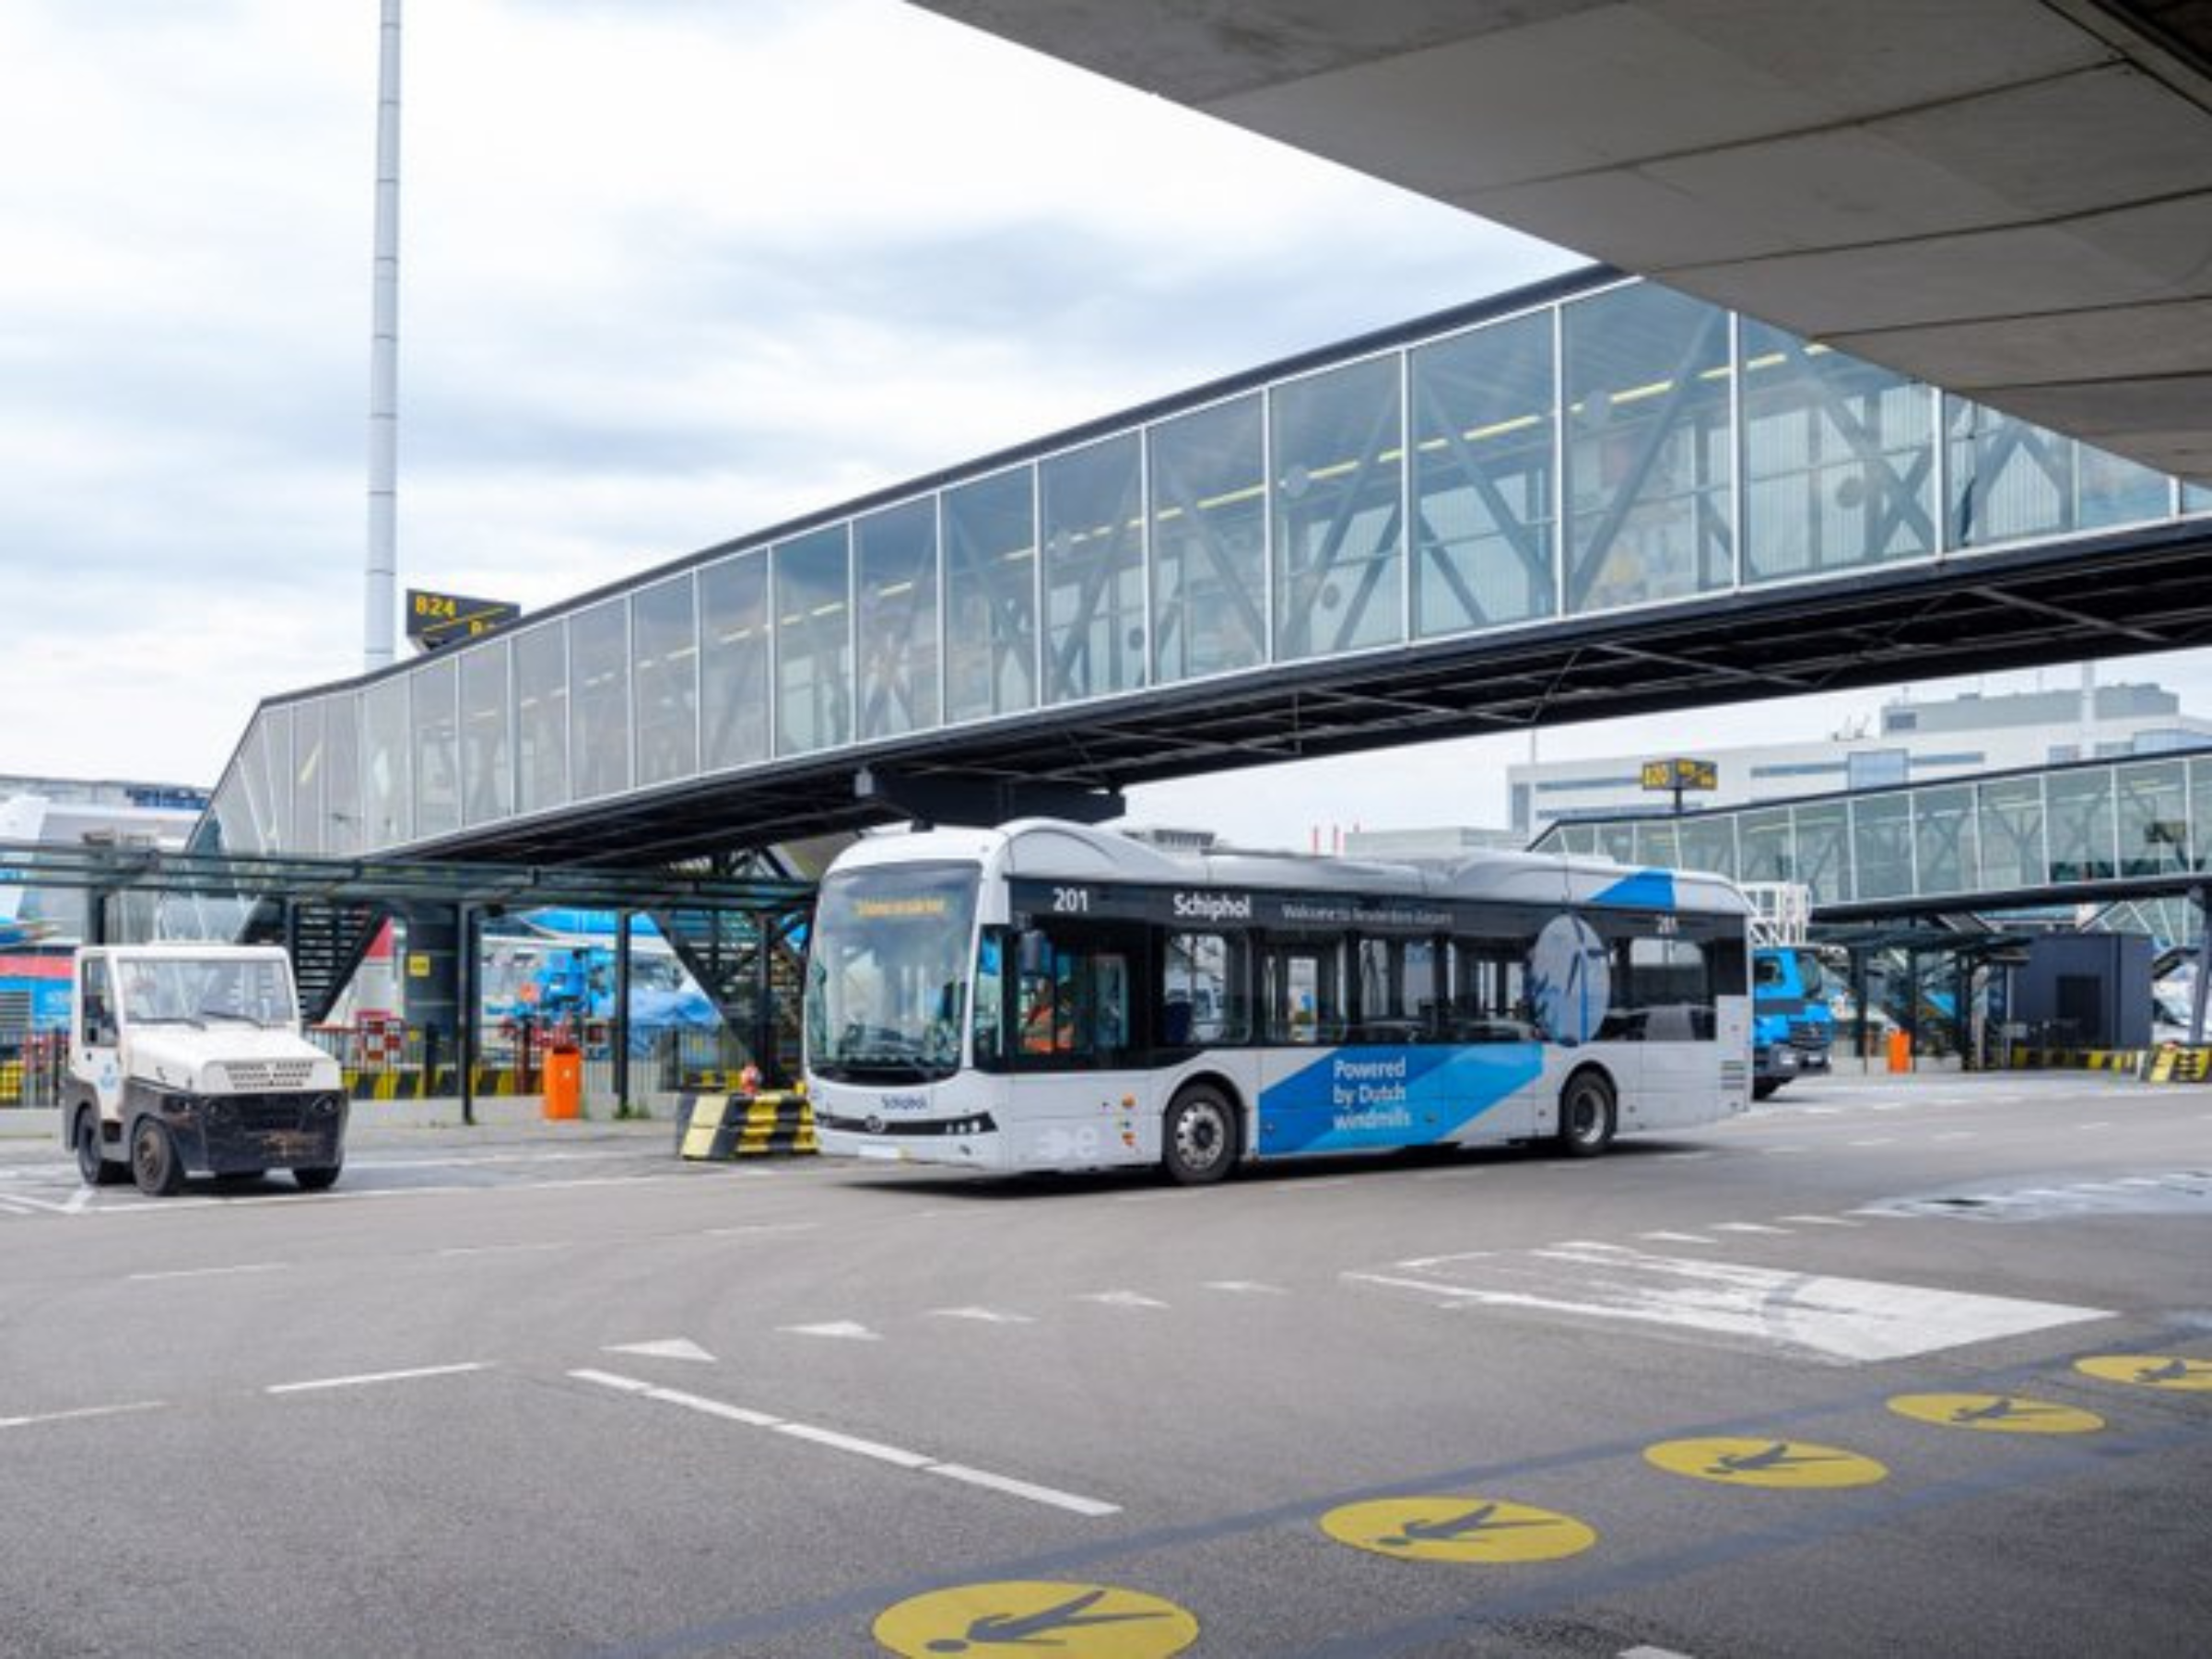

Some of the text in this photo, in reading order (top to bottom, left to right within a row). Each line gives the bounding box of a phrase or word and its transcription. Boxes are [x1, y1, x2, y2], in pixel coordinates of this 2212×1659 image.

[416, 594, 456, 618] B24
[1053, 888, 1088, 912] 201
[1172, 891, 1252, 921] Schiphol
[1333, 1057, 1406, 1080] Powered
[1333, 1082, 1406, 1110] by Dutch
[1333, 1106, 1412, 1130] windmills
